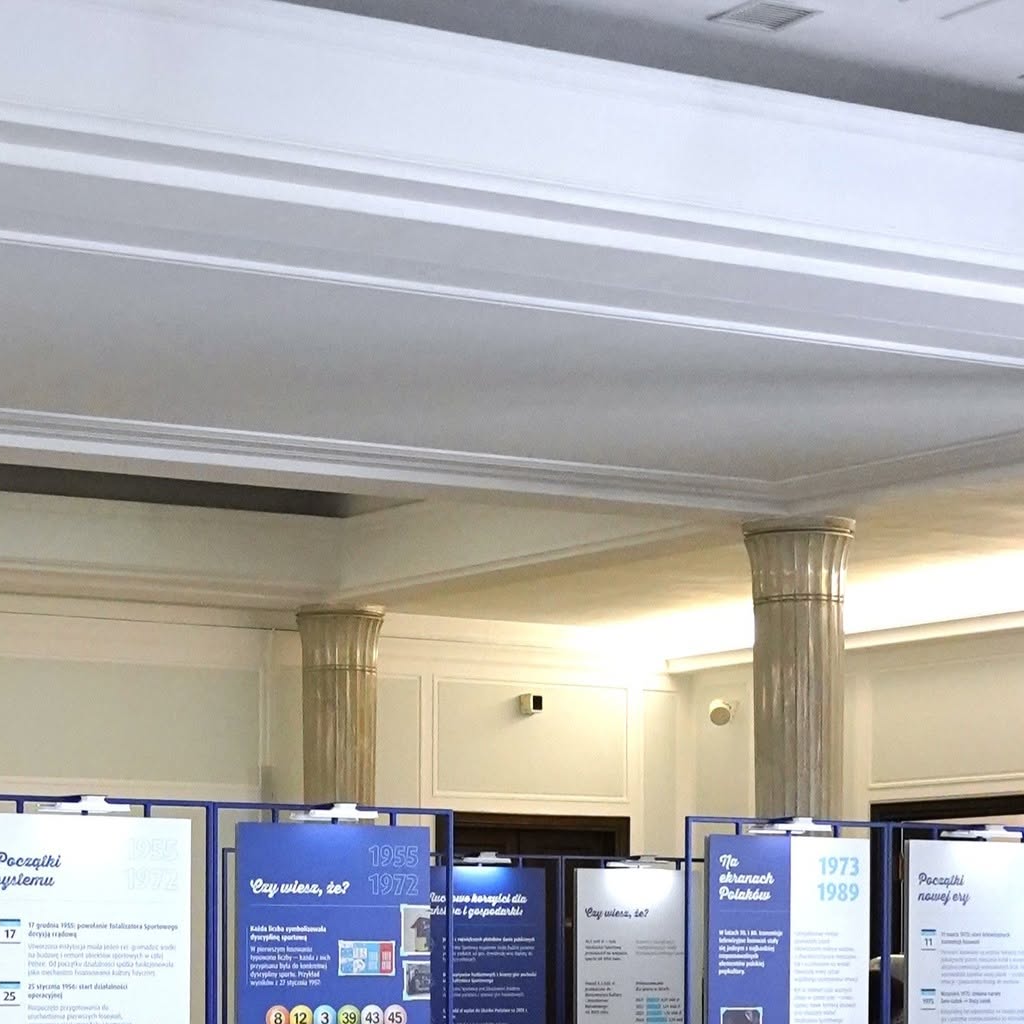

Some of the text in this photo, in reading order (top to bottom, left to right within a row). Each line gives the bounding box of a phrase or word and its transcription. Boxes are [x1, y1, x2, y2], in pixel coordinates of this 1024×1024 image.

[368, 844, 419, 868] 1955
[719, 854, 740, 870] Na
[818, 857, 860, 877] 1973
[368, 873, 419, 896] 1972
[719, 872, 775, 884] ekranach
[918, 872, 965, 888] Początki
[250, 878, 350, 898] Czy wiesz, że?
[719, 886, 772, 901] Polaków
[817, 883, 860, 902] 1989
[512, 893, 528, 904] dla
[918, 890, 970, 906] nowej ery
[584, 907, 603, 920] Czy
[604, 908, 632, 919] wiesz,
[144, 922, 179, 931] Sportowego
[4, 929, 16, 939] 17
[924, 938, 933, 946] 11
[3, 991, 16, 1002] 25
[274, 1011, 283, 1024] 8
[294, 1012, 307, 1024] 12
[321, 1011, 329, 1024] 3
[342, 1011, 357, 1024] 39
[365, 1011, 380, 1024] 43
[388, 1011, 403, 1024] 45
